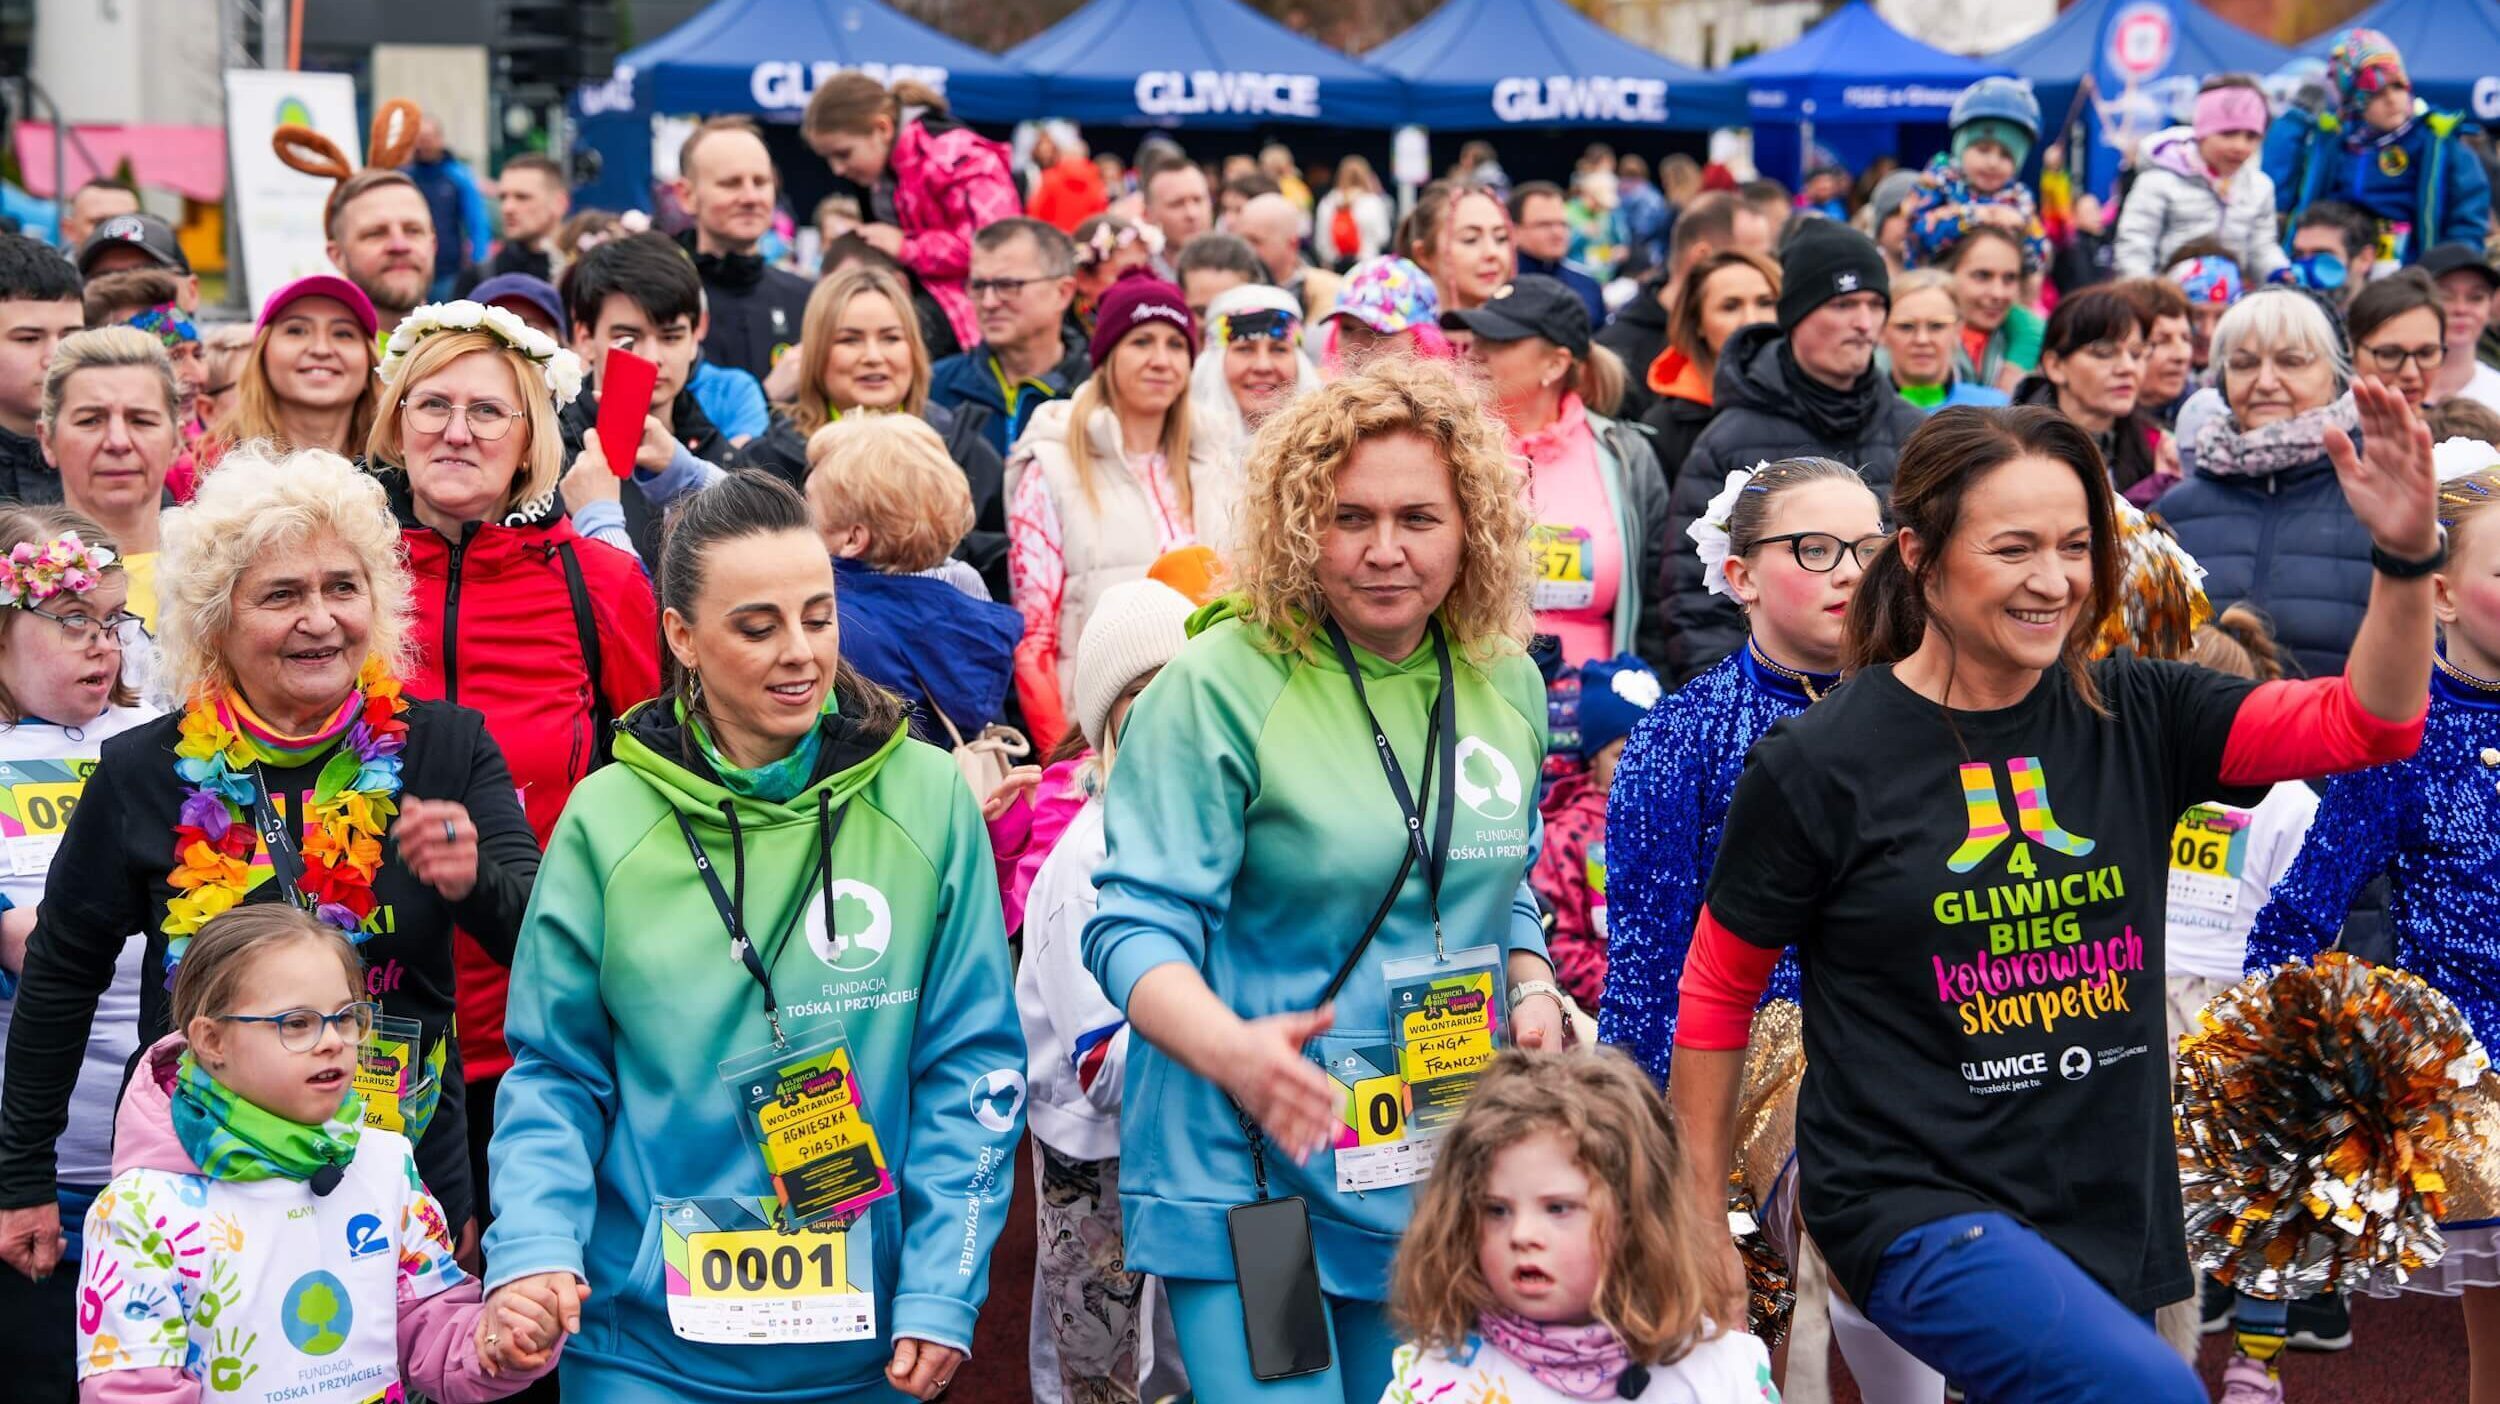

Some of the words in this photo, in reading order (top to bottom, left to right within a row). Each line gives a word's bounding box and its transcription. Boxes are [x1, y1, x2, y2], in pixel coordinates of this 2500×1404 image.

[1135, 71, 1320, 116] GLIWICE
[1493, 77, 1678, 122] GLIWICE
[2006, 842, 2038, 880] 4
[2169, 837, 2220, 870] 06
[1933, 865, 2125, 924] GLIWICKI
[1989, 912, 2082, 956] BIEG
[1932, 925, 2144, 1003] kolorowych
[786, 1000, 833, 1018] TOŚKA
[836, 1000, 841, 1012] I
[844, 987, 919, 1012] PRZYJACIELE
[822, 976, 887, 997] FUNDACJA
[1423, 994, 1434, 1007] 4
[1959, 970, 2130, 1035] skarpetek
[1409, 1014, 1484, 1035] WOLONTARIUSZ
[1420, 1034, 1472, 1054] KINGA
[776, 1083, 787, 1097] 4
[784, 1070, 818, 1087] GLIWICKI
[1961, 1052, 2049, 1082] GLIWICE
[1969, 1080, 2011, 1096] Przyszłość
[2012, 1079, 2029, 1093] jest
[766, 1091, 846, 1127] WOLONTARIUSZ
[1369, 1092, 1407, 1136] 0
[783, 1110, 848, 1144] AGNIESZKA
[798, 1132, 850, 1161] PIASTA
[702, 1243, 833, 1292] 0001
[264, 1384, 309, 1404] TOŚKA
[318, 1364, 383, 1393] PRZYJACIELE
[298, 1359, 353, 1381] FUNDACJA
